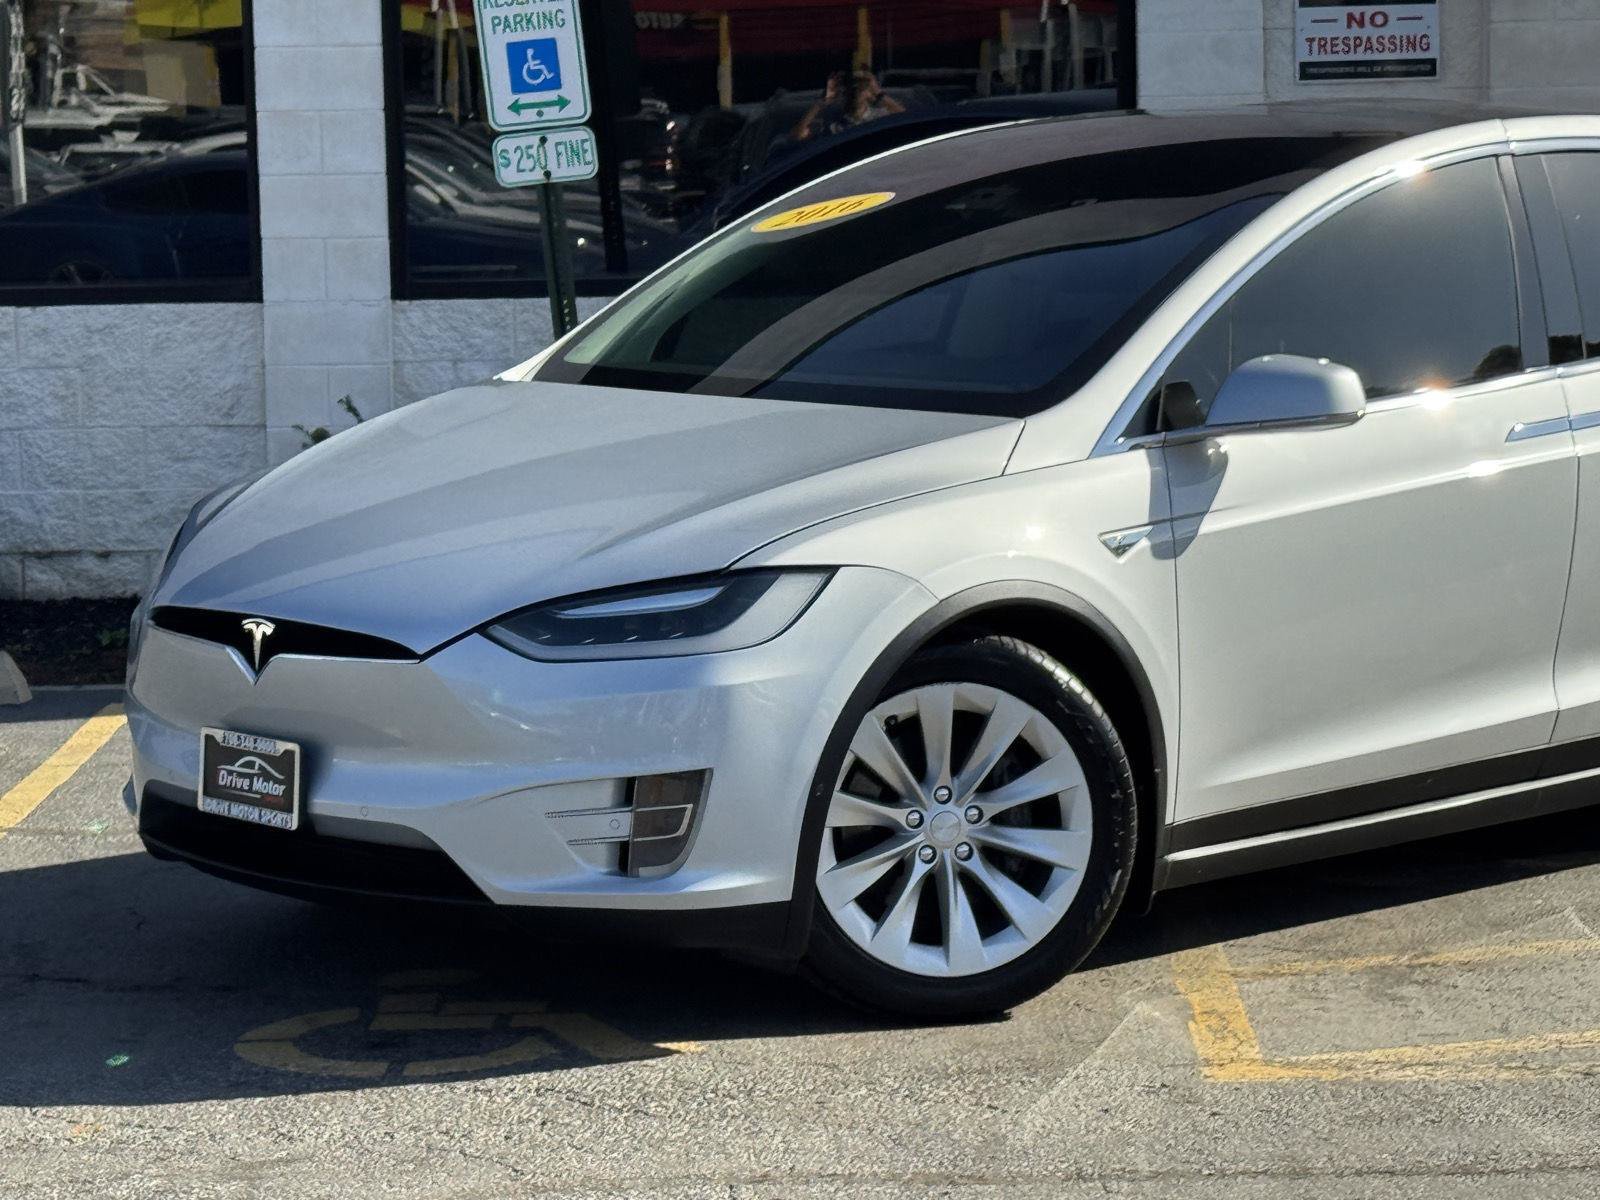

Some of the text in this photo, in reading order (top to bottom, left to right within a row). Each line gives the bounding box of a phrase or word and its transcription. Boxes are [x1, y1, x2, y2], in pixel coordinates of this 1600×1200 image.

[491, 9, 566, 34] PARKING
[1346, 11, 1389, 29] NO
[1305, 33, 1431, 56] TRESPASSING
[555, 138, 593, 168] FINE
[218, 769, 287, 796] Drive Motor
[230, 803, 260, 823] MOTOR
